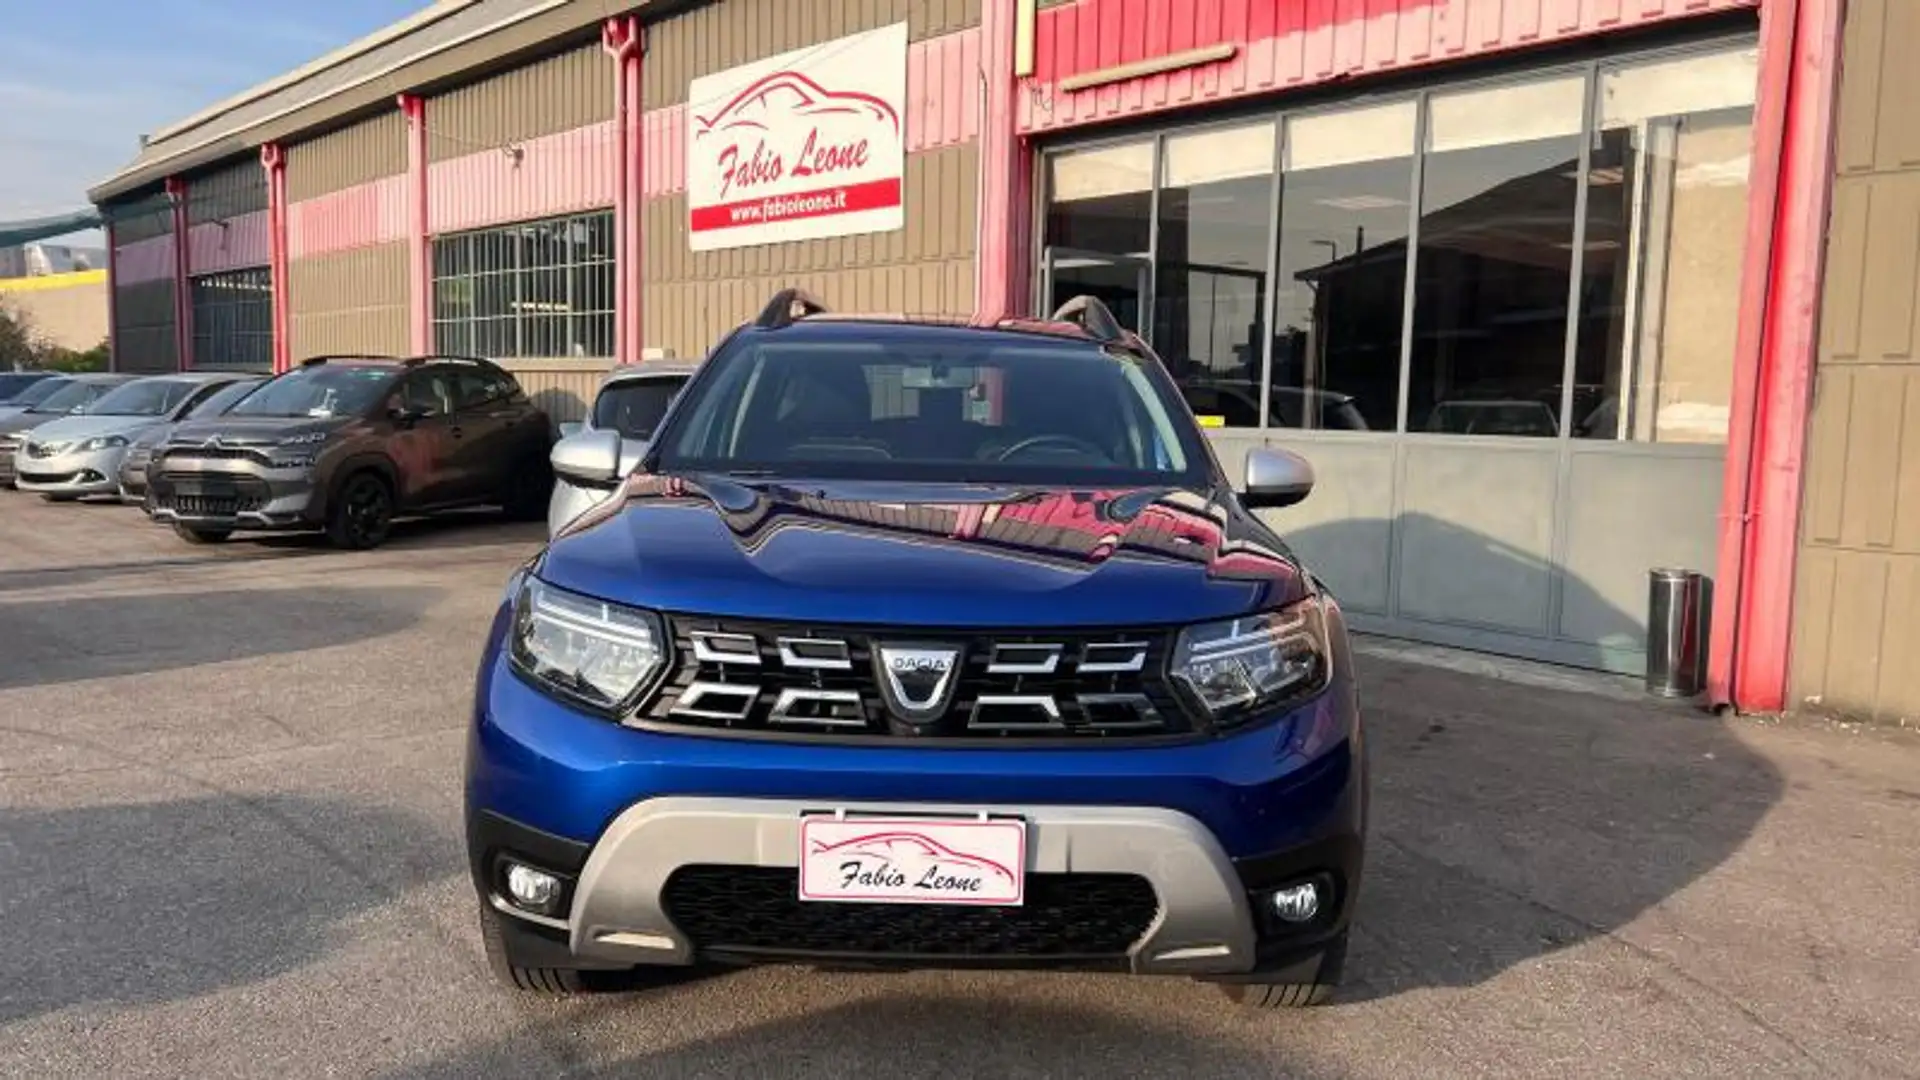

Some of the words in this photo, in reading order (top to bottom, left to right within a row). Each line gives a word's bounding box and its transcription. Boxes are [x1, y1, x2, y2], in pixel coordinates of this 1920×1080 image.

[718, 139, 783, 200] Fabio
[790, 127, 868, 177] Leone
[729, 191, 847, 222] www.fabioleone.it
[895, 657, 945, 668] DACIA
[839, 861, 906, 889] Fabio
[914, 865, 983, 892] Leone
